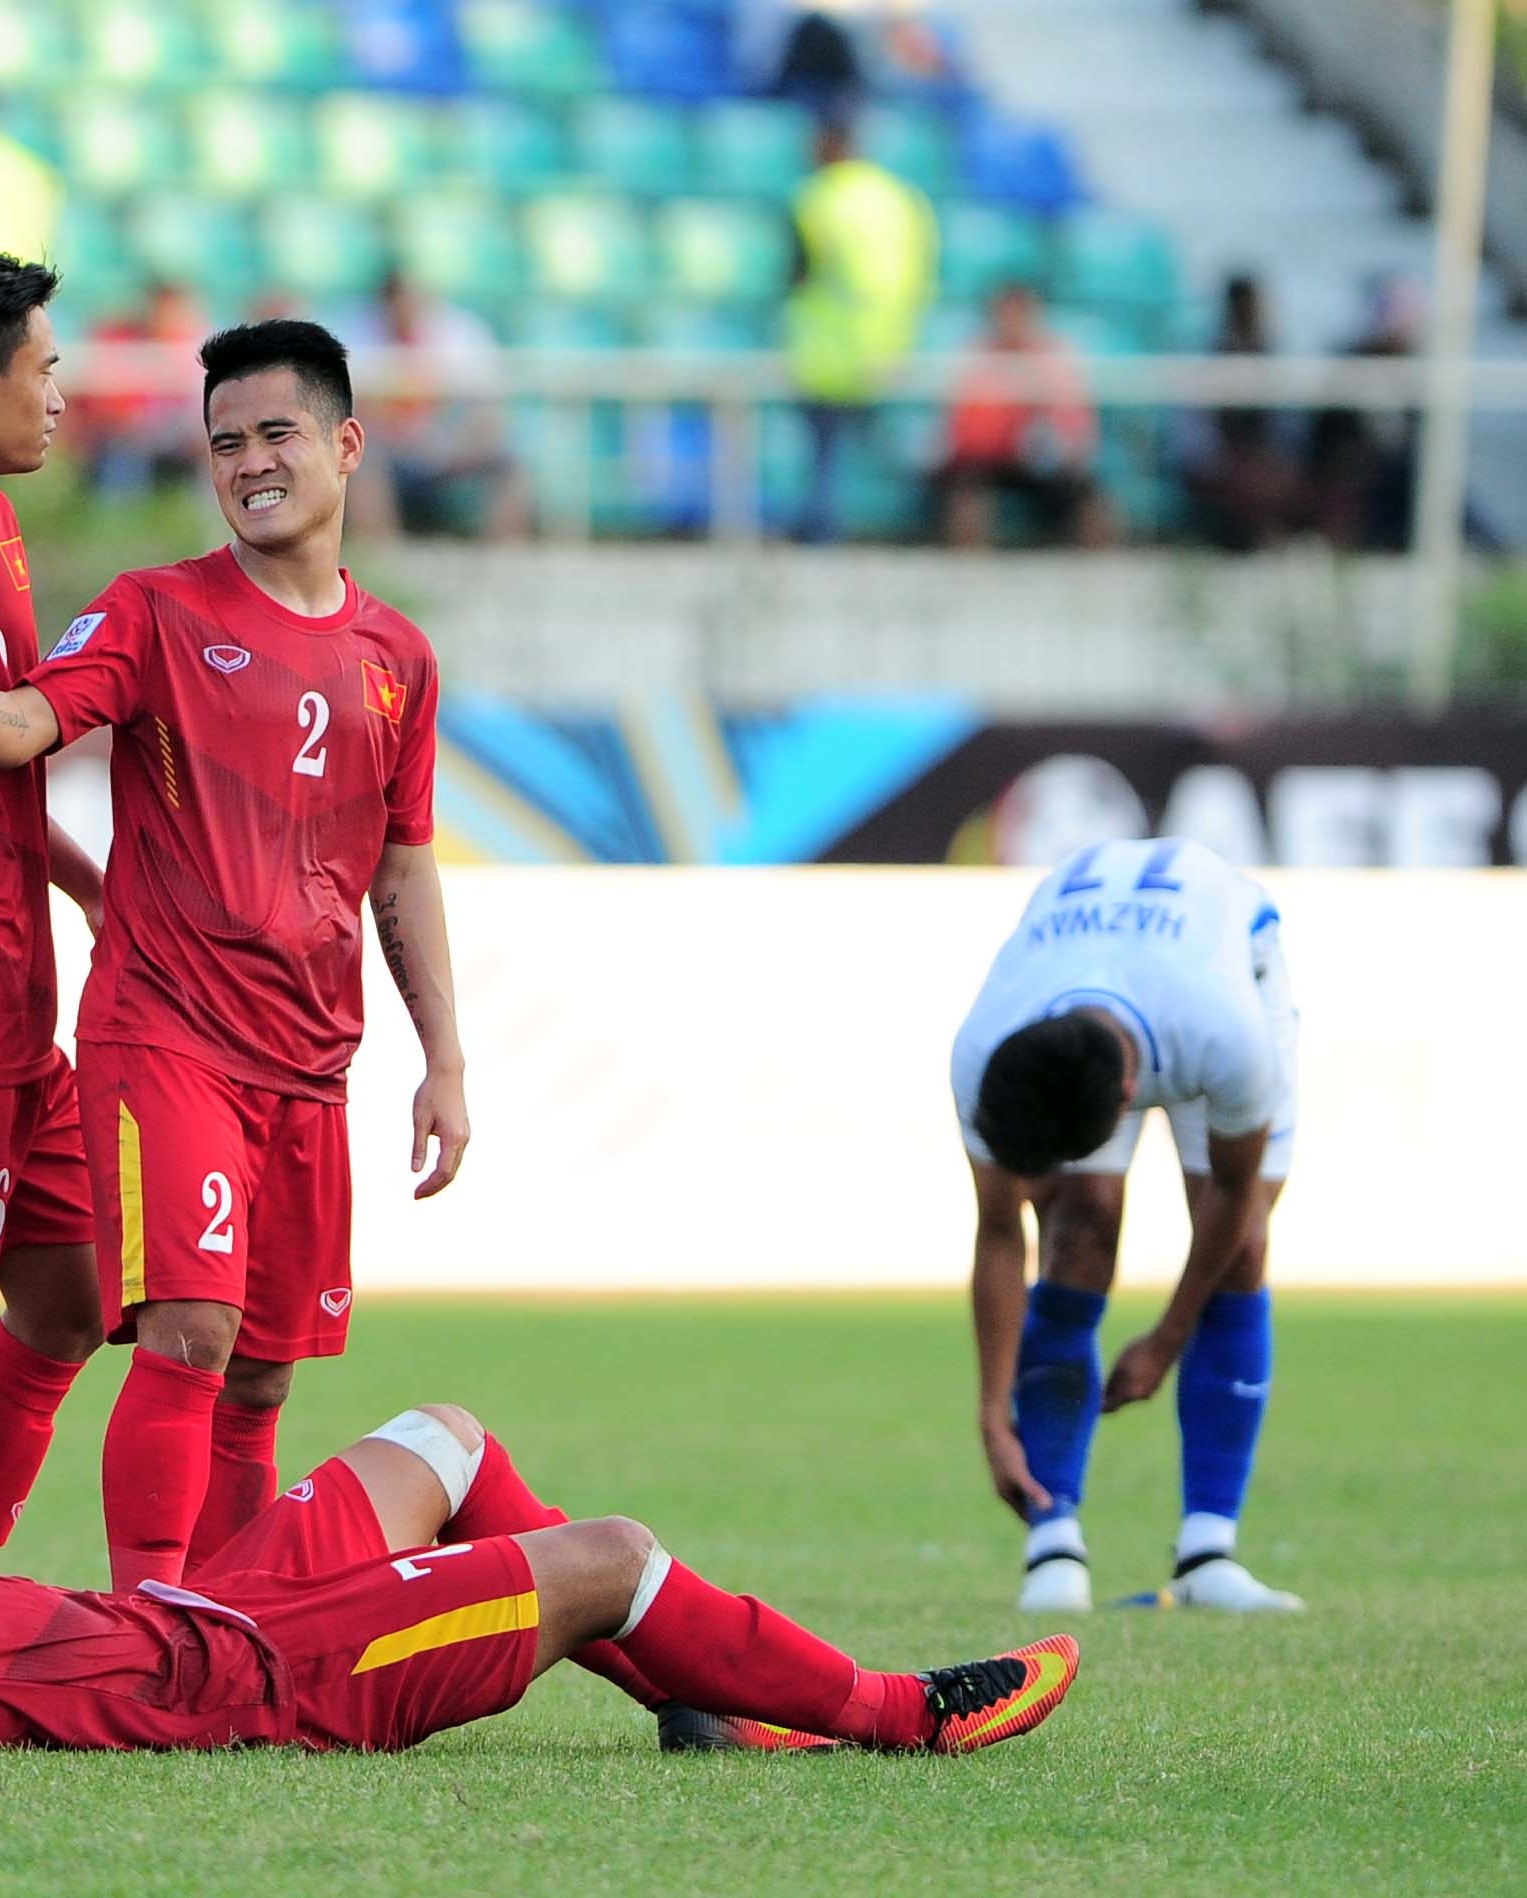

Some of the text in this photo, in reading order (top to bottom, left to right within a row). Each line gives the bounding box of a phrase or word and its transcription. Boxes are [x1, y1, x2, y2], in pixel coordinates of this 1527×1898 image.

[292, 690, 331, 778] 2
[1027, 902, 1186, 947] HAZWAN
[198, 1171, 235, 1255] 2
